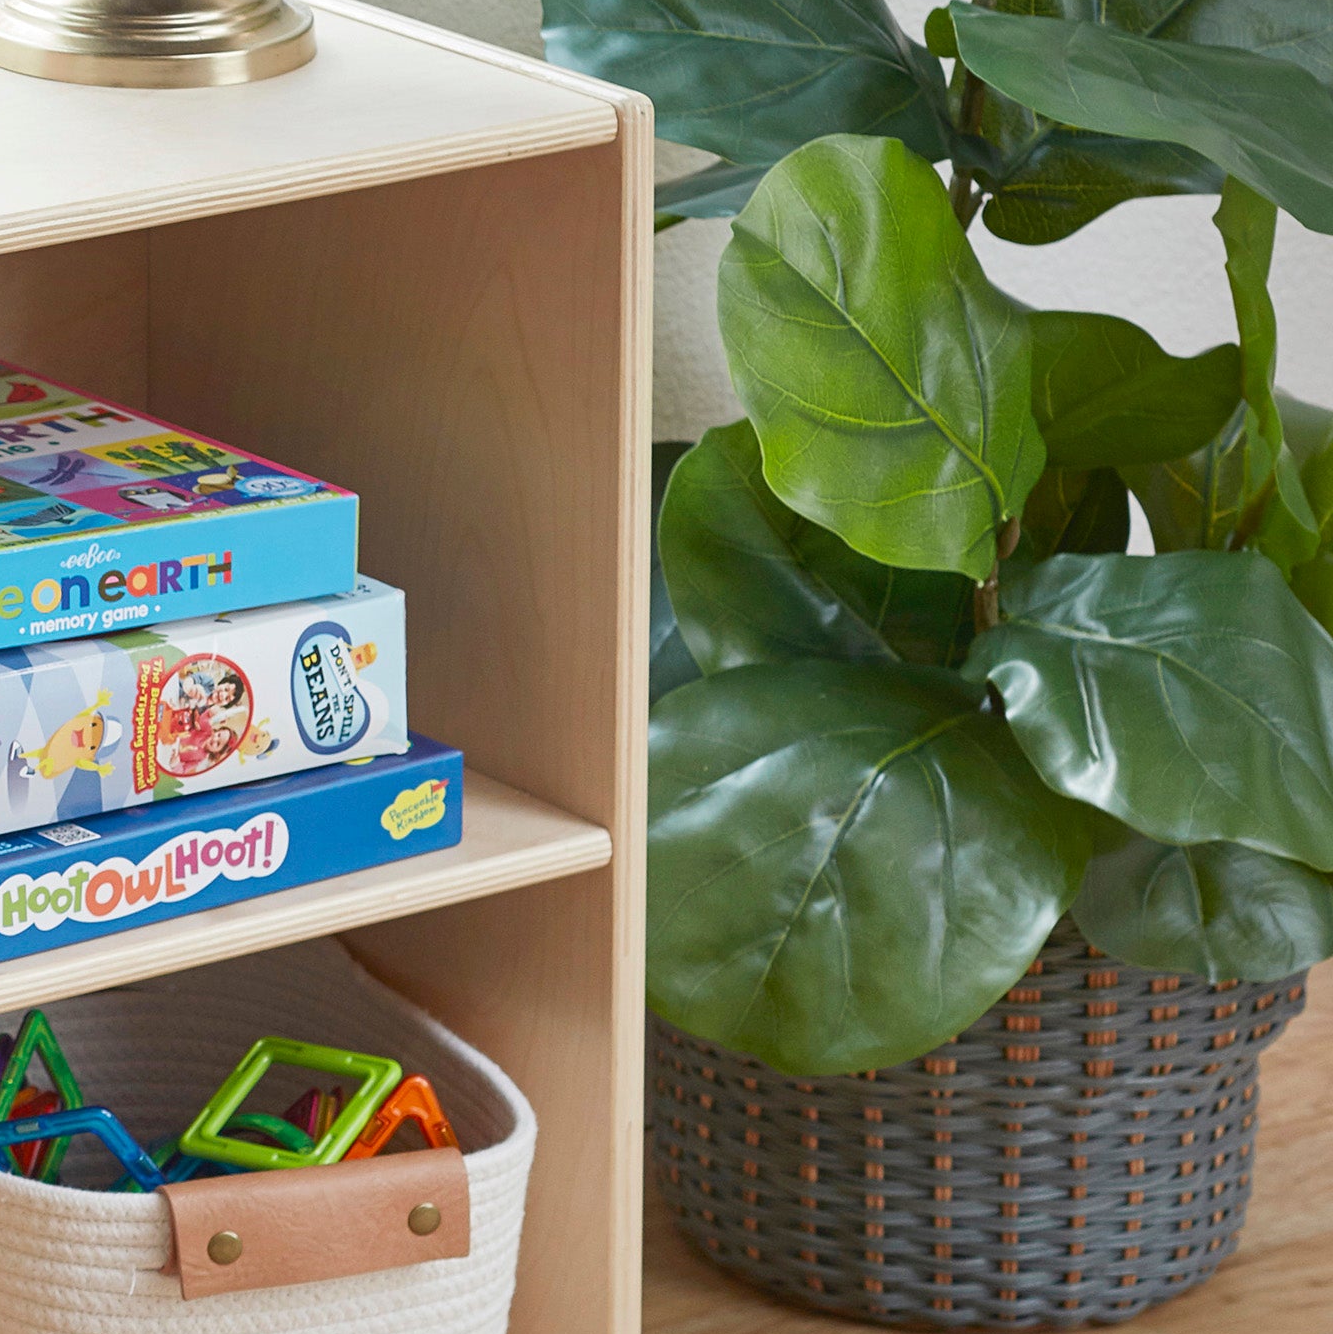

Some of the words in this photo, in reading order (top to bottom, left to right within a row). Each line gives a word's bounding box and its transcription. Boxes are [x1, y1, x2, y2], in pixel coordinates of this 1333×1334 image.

[32, 574, 90, 613] on
[30, 609, 99, 635] memory
[102, 604, 149, 628] game
[152, 660, 163, 684] The
[329, 644, 352, 688] DON'T
[132, 664, 150, 749] Pot-Tipping
[300, 644, 334, 742] BEANS
[331, 693, 341, 714] THE
[339, 694, 355, 744] SPILL
[136, 750, 145, 791] Game!
